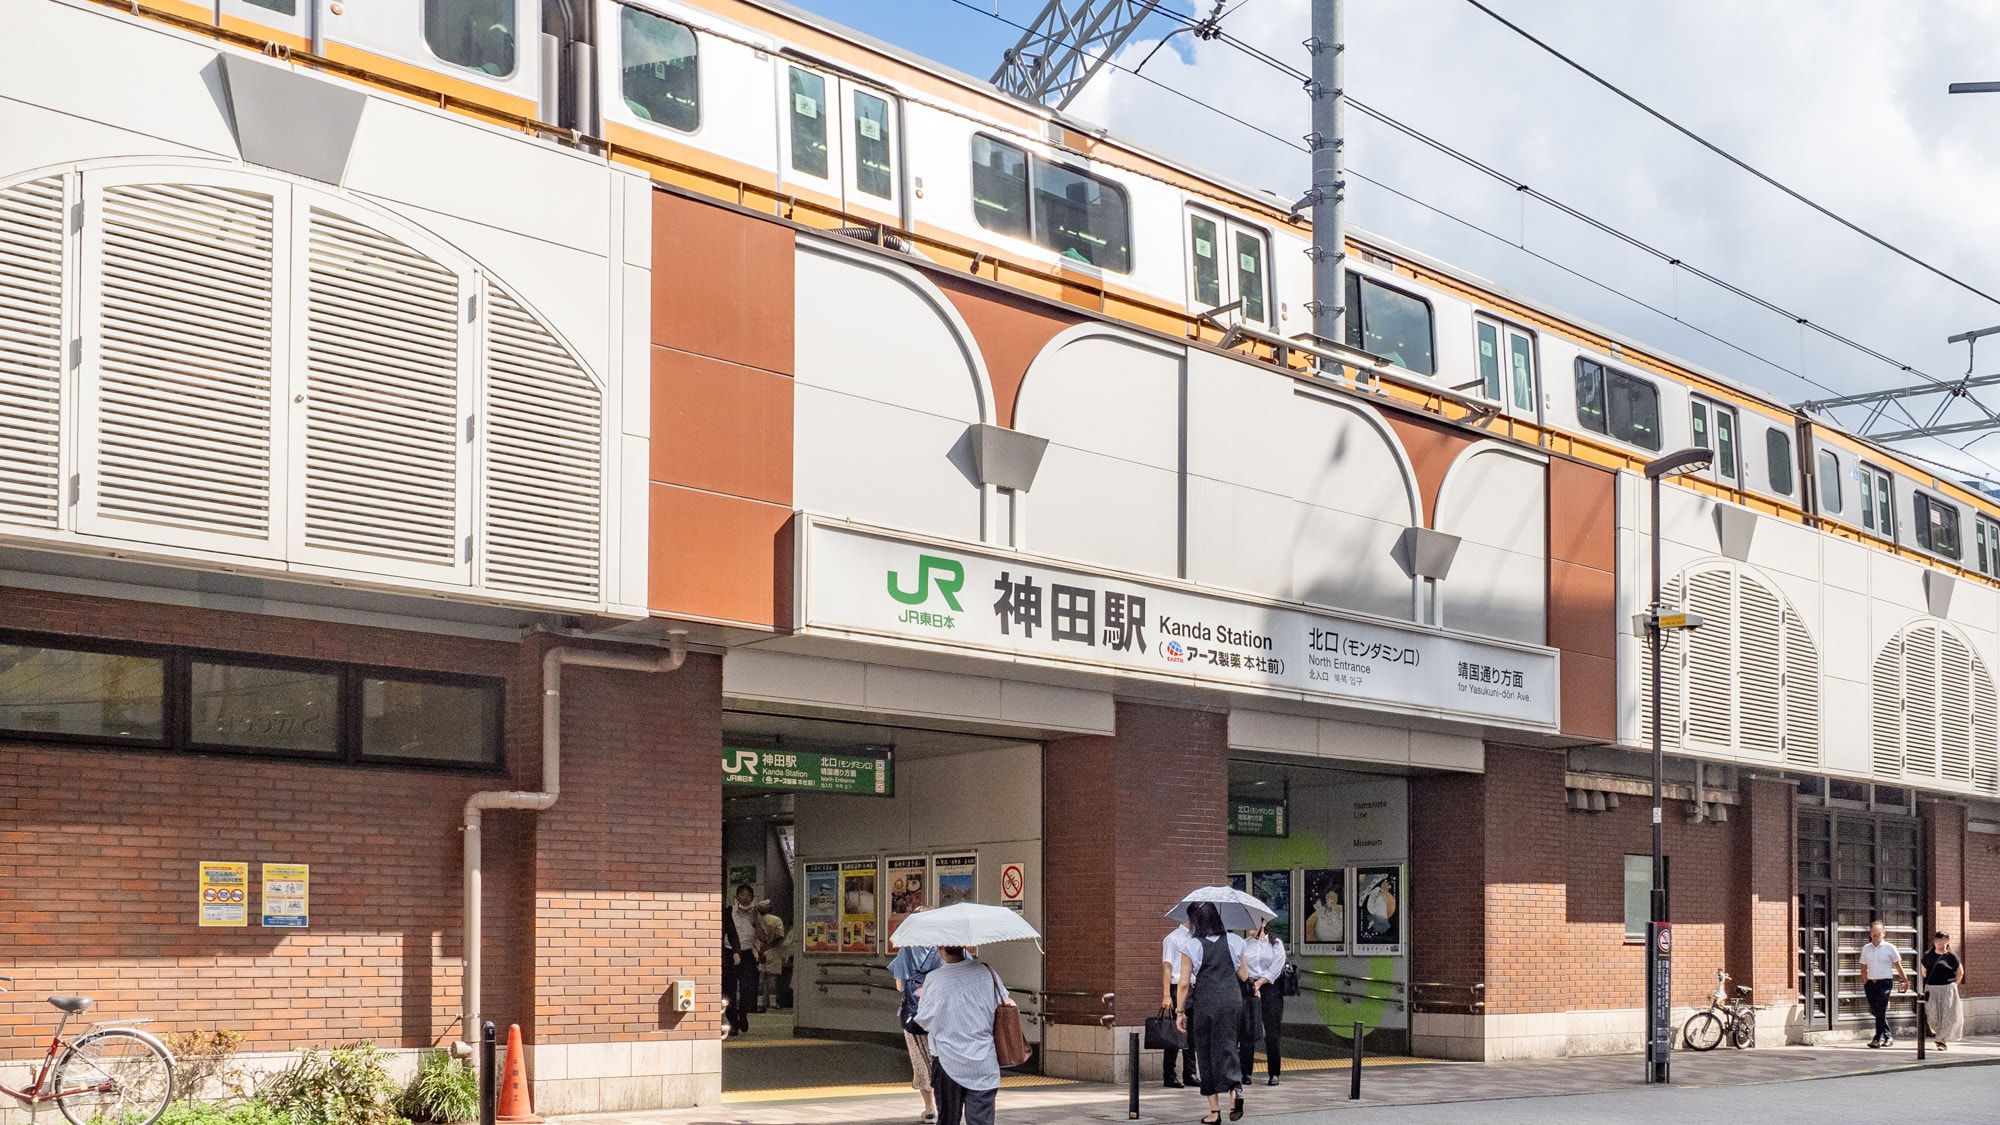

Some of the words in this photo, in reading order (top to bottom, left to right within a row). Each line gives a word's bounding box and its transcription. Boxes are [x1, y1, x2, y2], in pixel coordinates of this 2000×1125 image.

[887, 554, 965, 613] JR
[898, 609, 955, 629] JR東日本
[993, 571, 1148, 655] 神田駅
[1159, 615, 1211, 642] Kanda
[1216, 624, 1273, 651] Station
[1308, 654, 1331, 668] North
[1334, 658, 1371, 674] Entrance
[1308, 669, 1329, 681] 北入口
[1458, 661, 1524, 688] 靖国通り方面
[1458, 682, 1467, 692] for
[1517, 692, 1532, 702] Ave.
[722, 750, 758, 775] JR
[762, 752, 797, 768] 神田駅
[762, 768, 784, 776] Kanda
[785, 769, 808, 778] Station
[1353, 801, 1387, 810] Yamanote
[1353, 811, 1369, 819] Line
[1353, 839, 1383, 848] Museum
